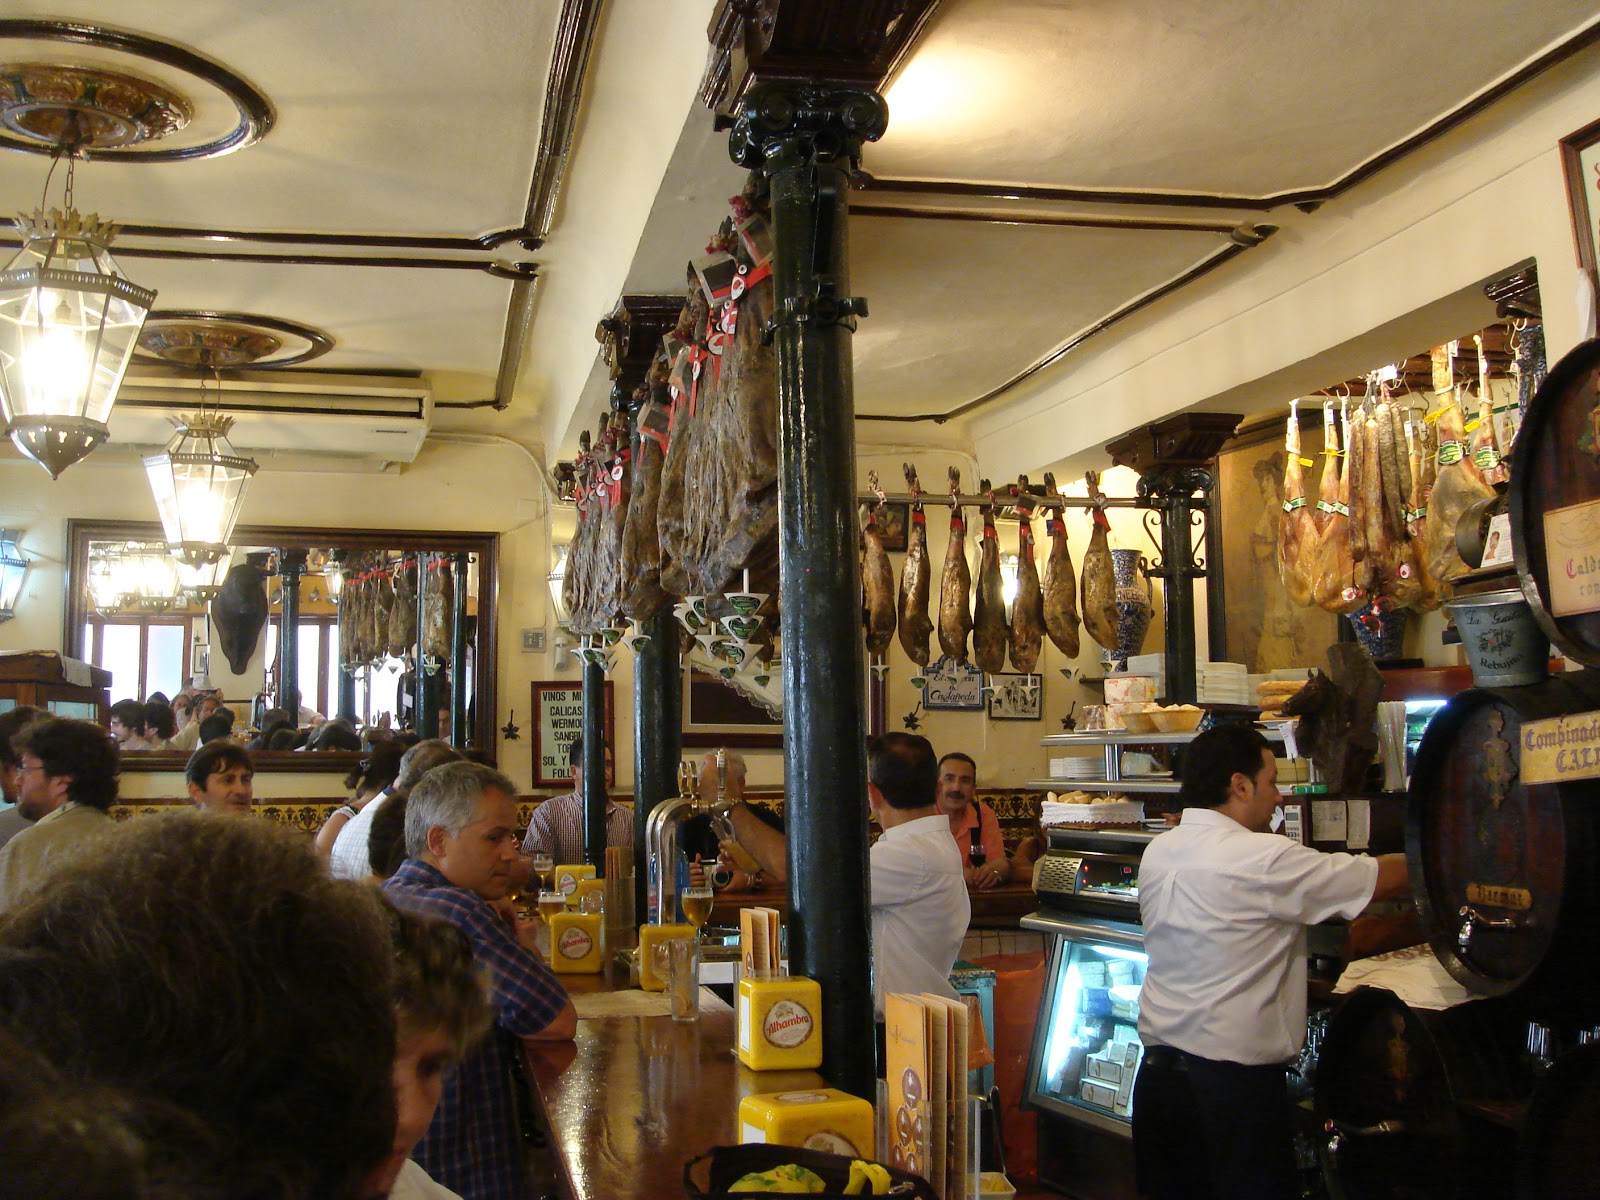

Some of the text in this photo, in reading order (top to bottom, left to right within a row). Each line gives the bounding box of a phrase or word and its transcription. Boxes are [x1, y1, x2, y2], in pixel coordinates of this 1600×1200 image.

[542, 691, 566, 701] VINOS
[550, 706, 583, 716] CALICAS
[542, 756, 557, 766] SOL
[562, 755, 567, 766] Y
[552, 768, 572, 778] FOLL
[767, 1014, 809, 1036] Alhambra
